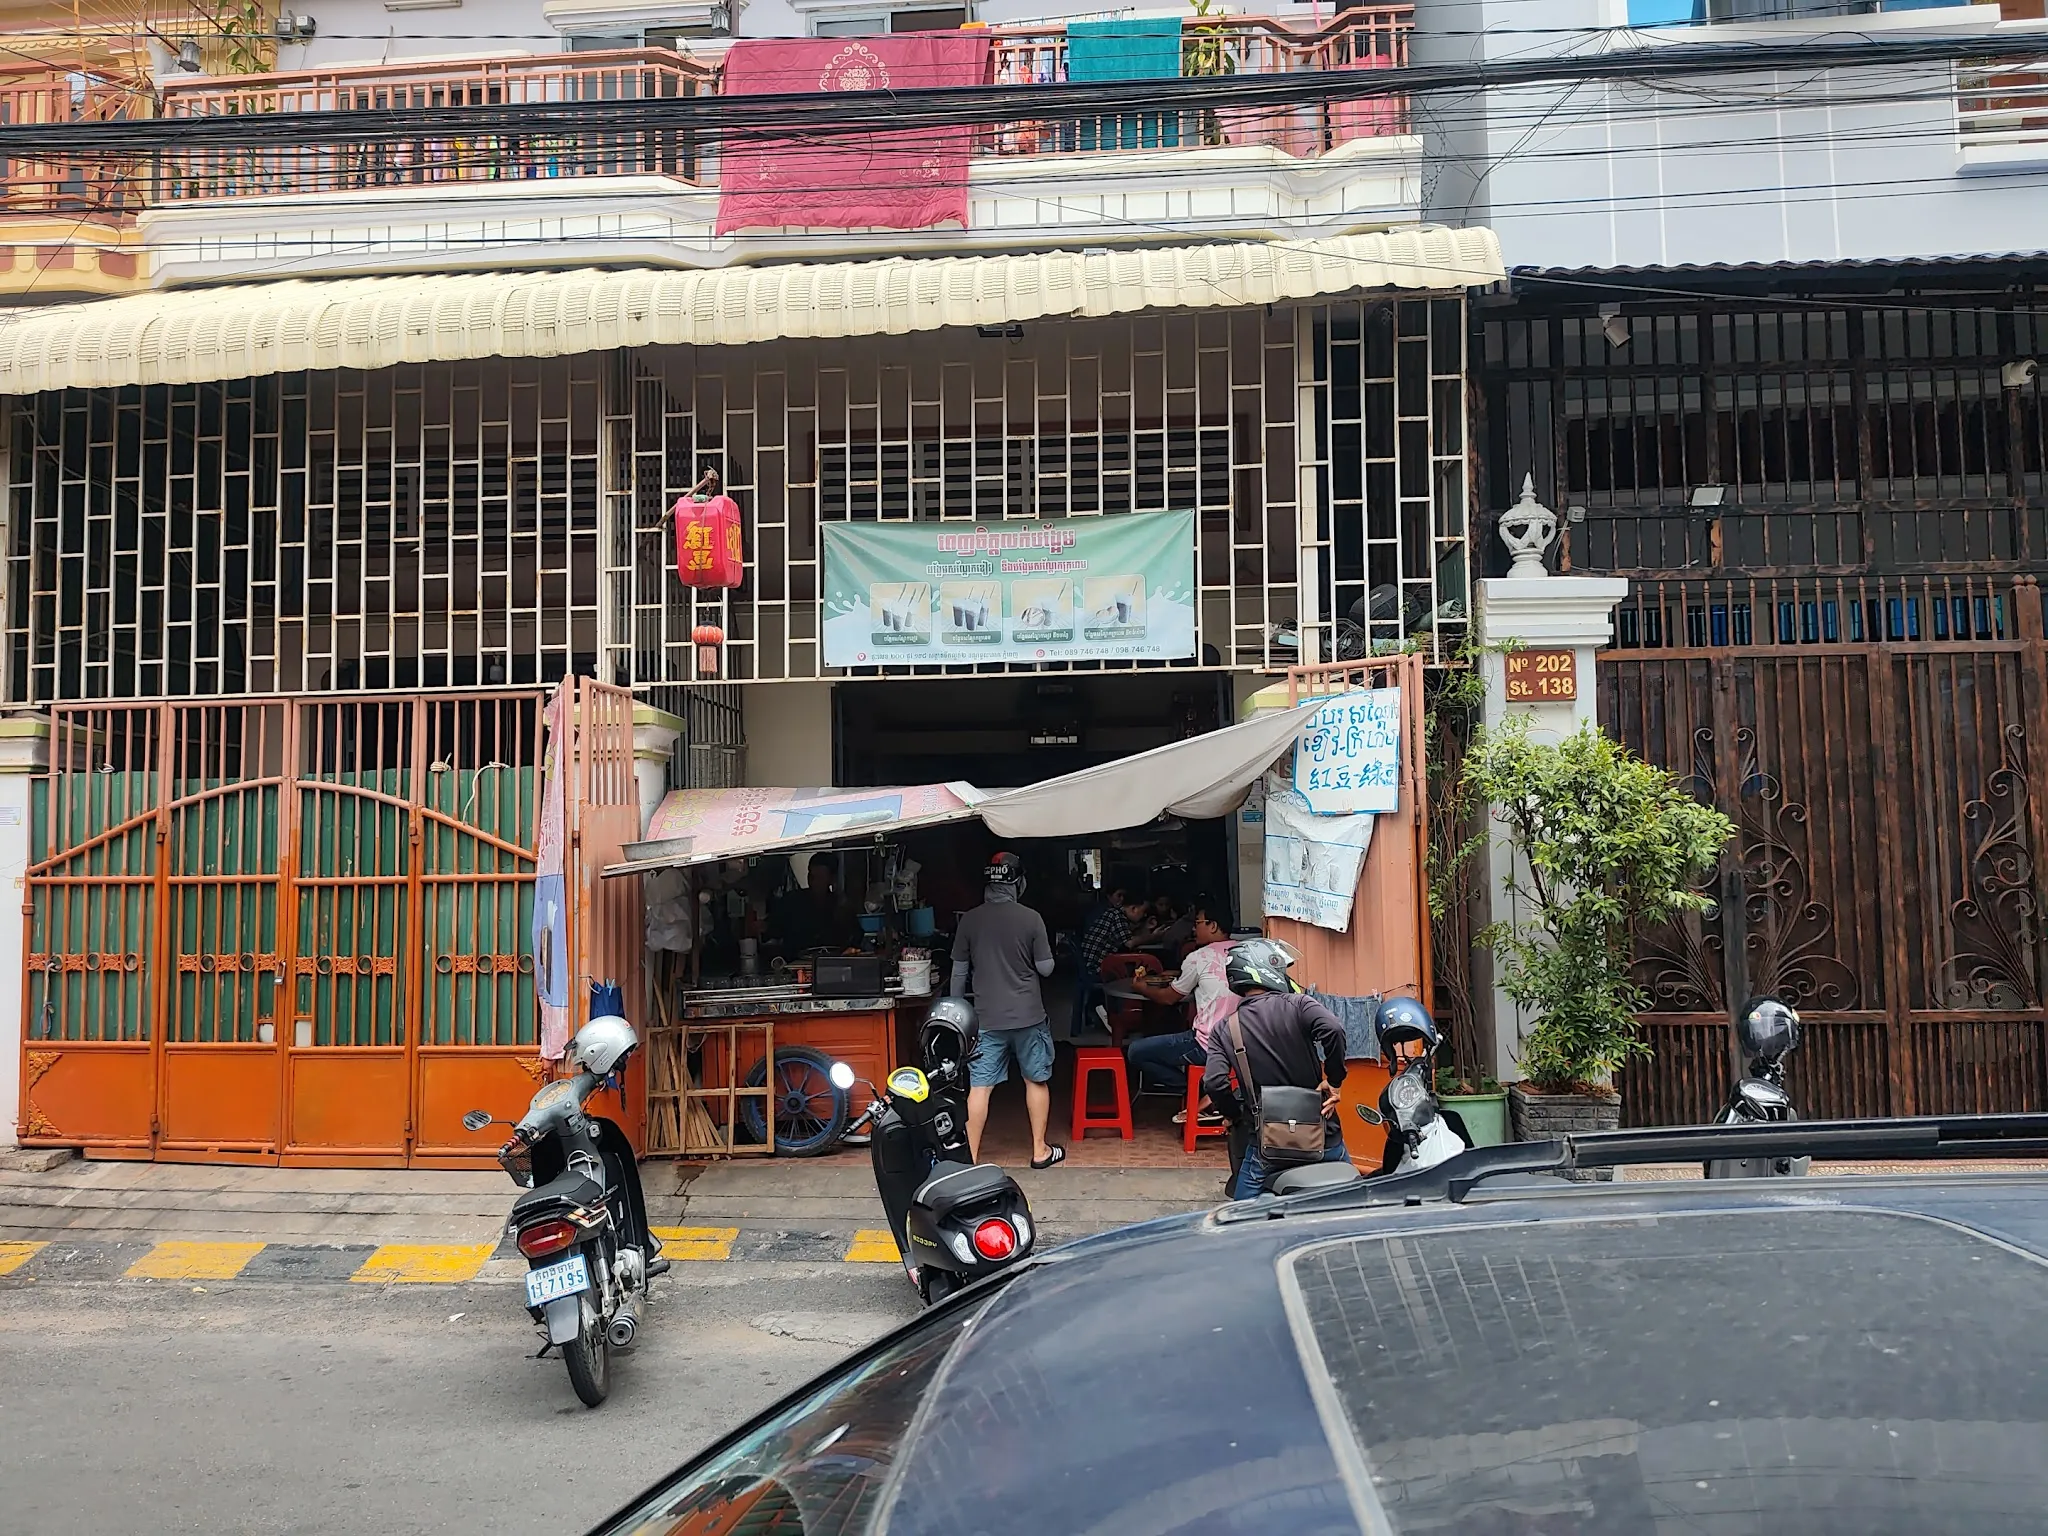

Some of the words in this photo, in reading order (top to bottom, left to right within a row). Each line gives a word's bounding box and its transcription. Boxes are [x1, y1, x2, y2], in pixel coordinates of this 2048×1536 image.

[1536, 654, 1571, 673] 202
[1509, 680, 1533, 695] St.
[1538, 677, 1574, 695] 138
